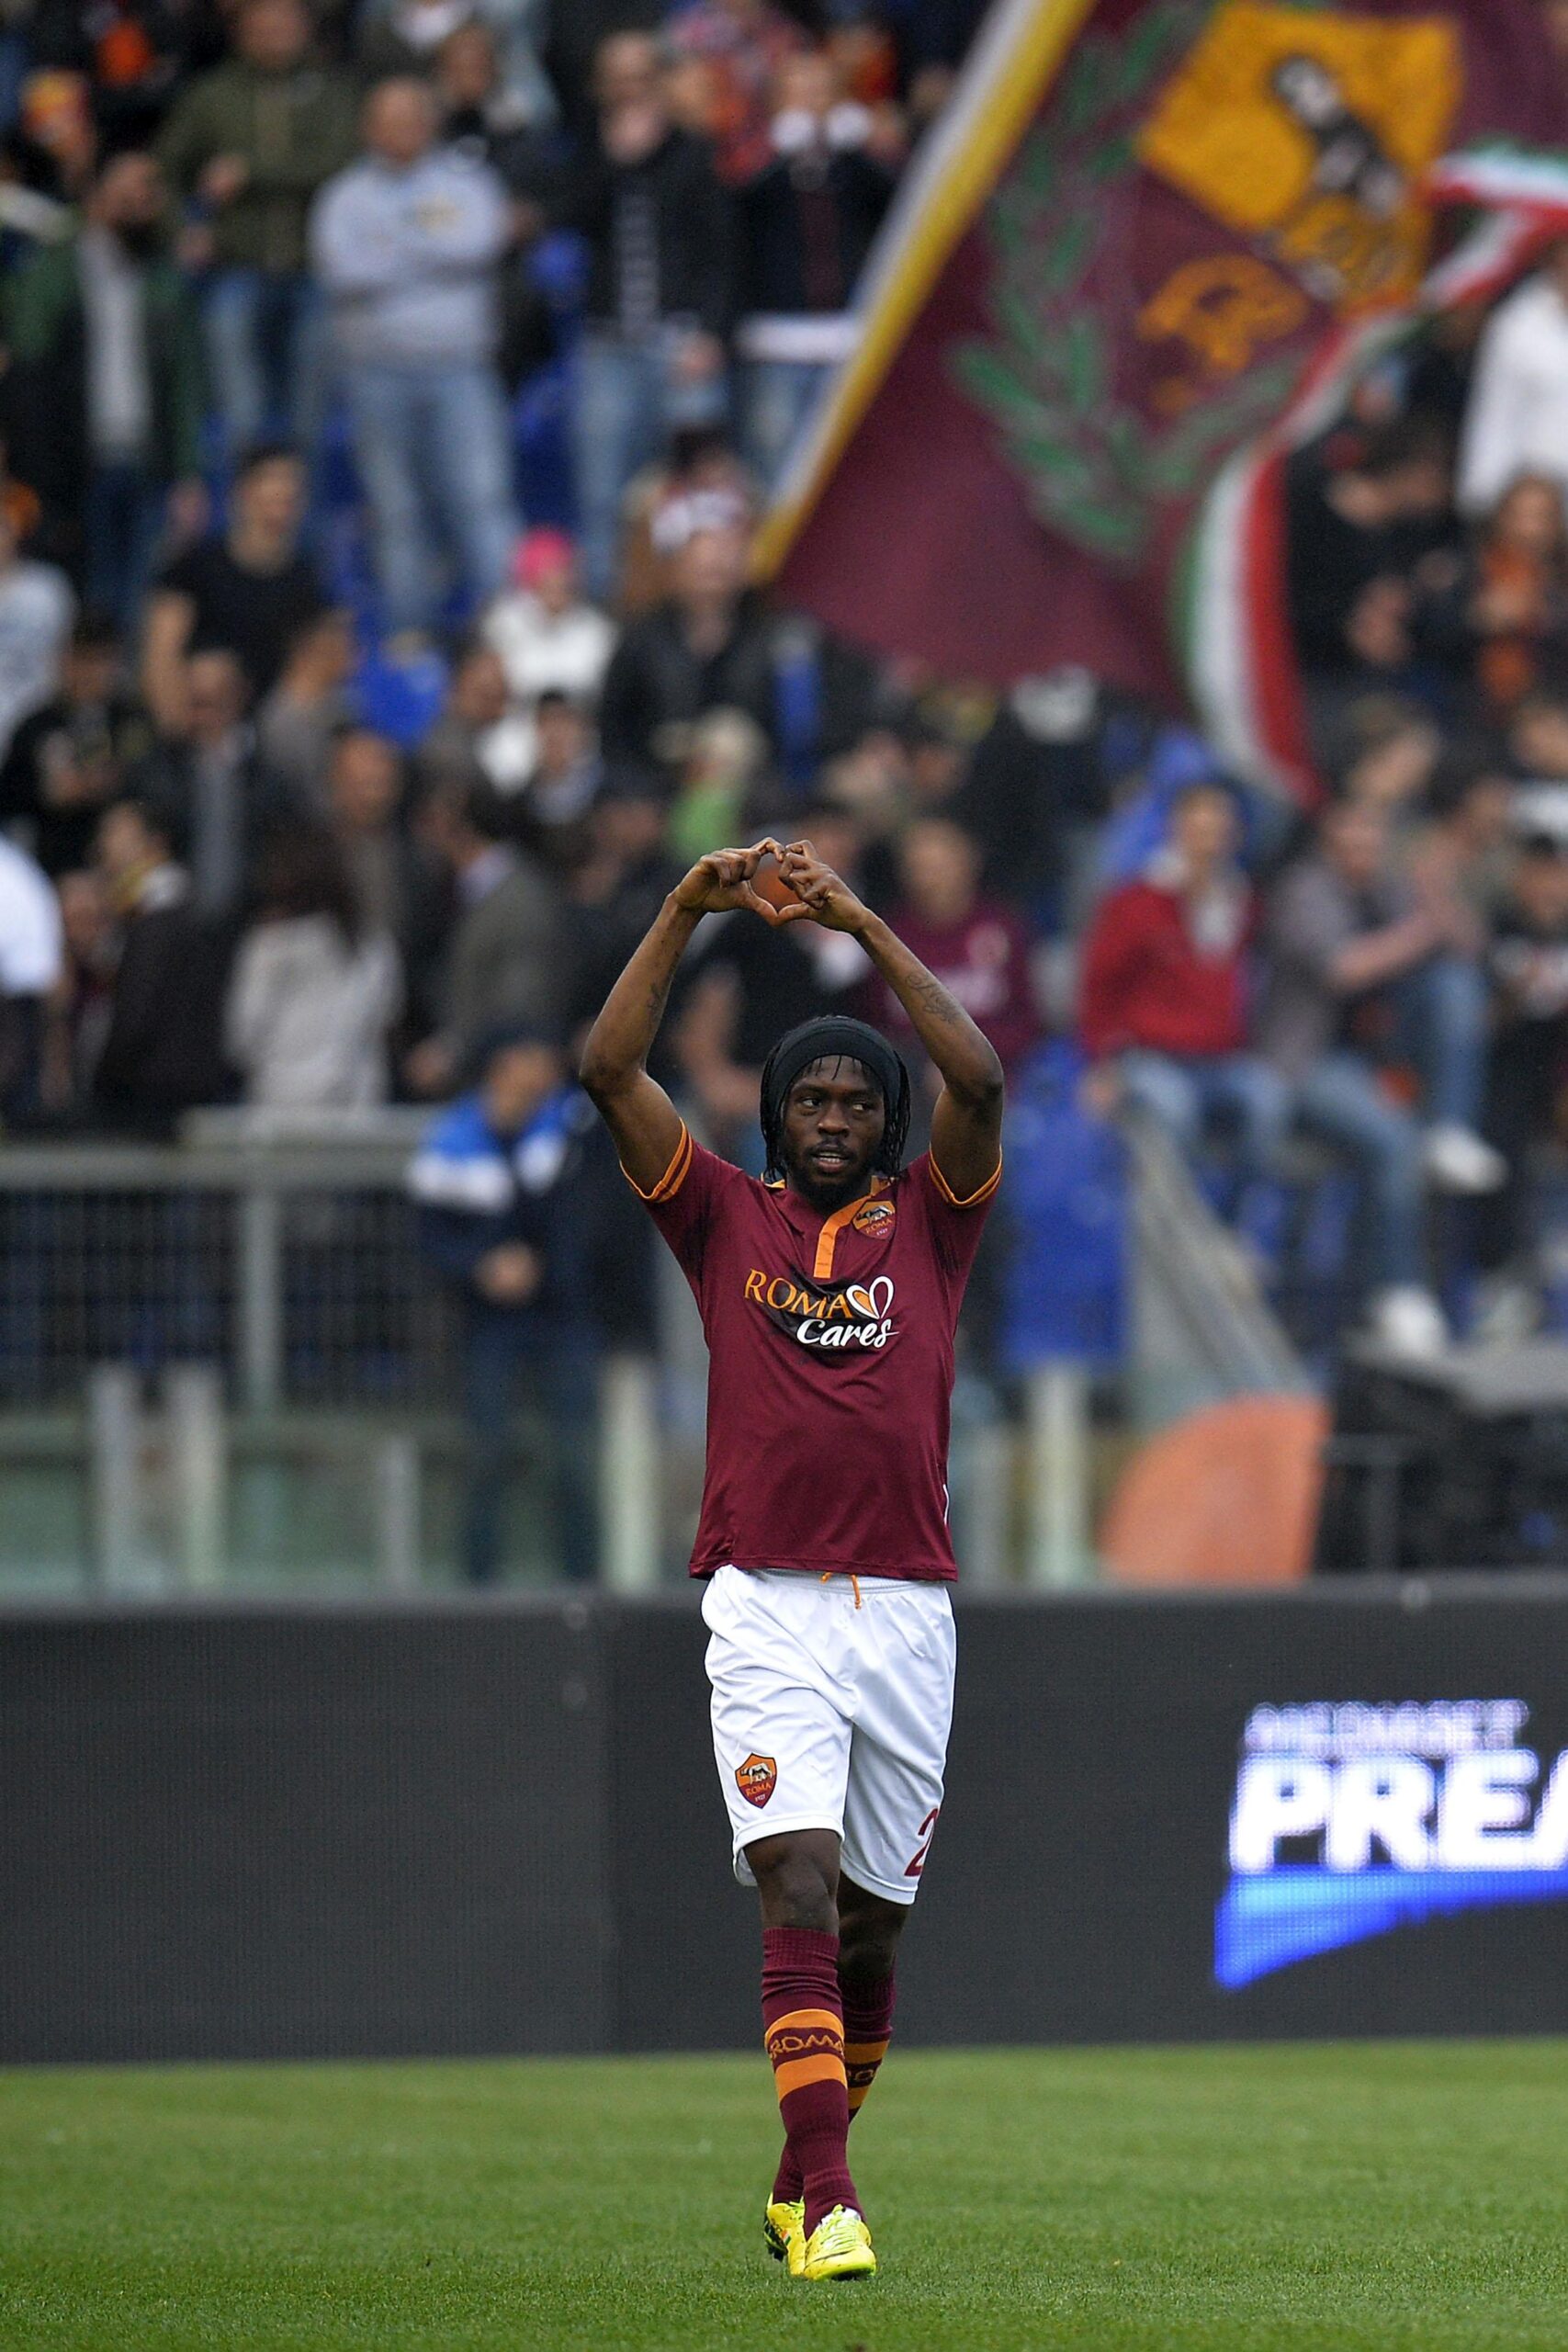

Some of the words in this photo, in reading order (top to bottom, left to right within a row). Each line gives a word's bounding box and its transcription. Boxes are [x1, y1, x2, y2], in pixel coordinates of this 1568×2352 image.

[865, 1218, 893, 1234] ROMA
[744, 1268, 853, 1319] ROMA
[796, 1318, 900, 1349] Cares
[745, 1781, 773, 1797] ROMA
[770, 2034, 845, 2060] ROMA
